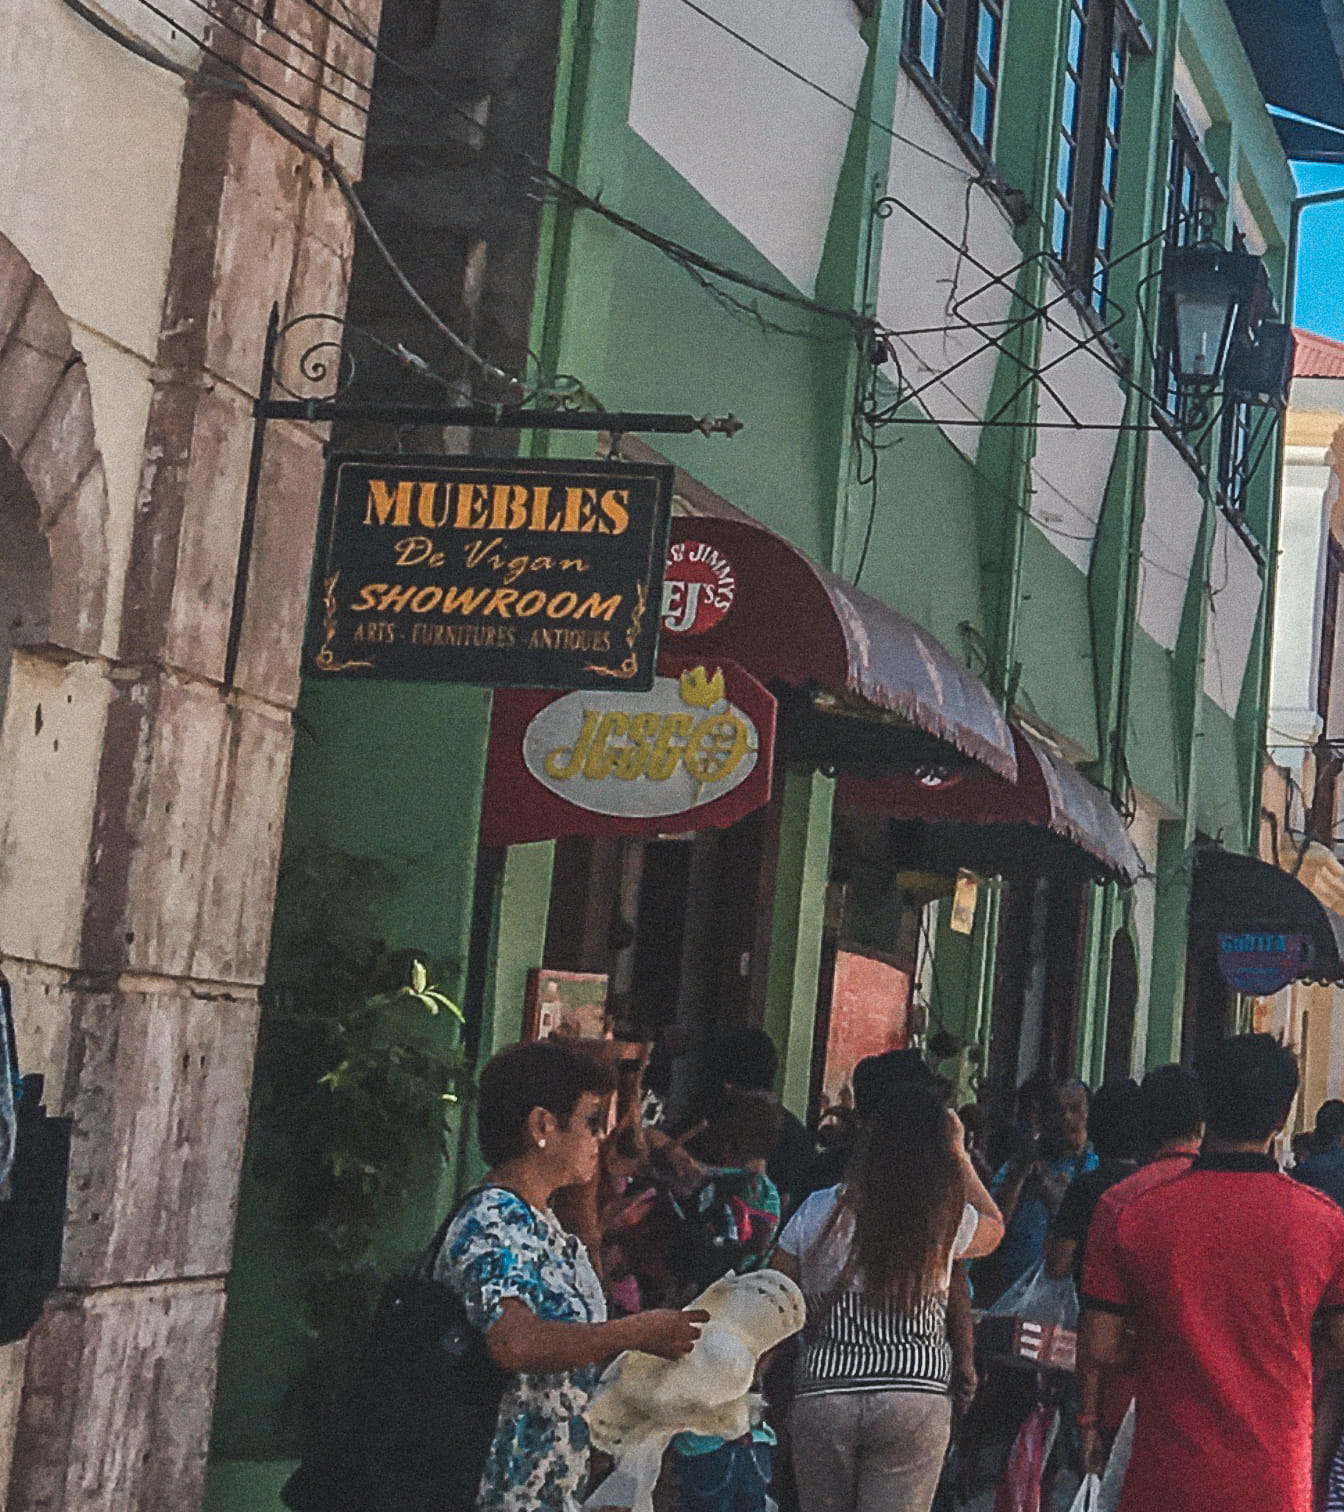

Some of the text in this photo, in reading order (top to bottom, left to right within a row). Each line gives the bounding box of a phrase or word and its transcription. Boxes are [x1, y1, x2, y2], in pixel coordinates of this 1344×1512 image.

[363, 479, 630, 535] MUEBLES
[394, 536, 589, 586] De Vigan
[351, 583, 623, 622] SHOWROOM
[353, 622, 395, 644] ARTS
[527, 627, 611, 652] ANTIQUES
